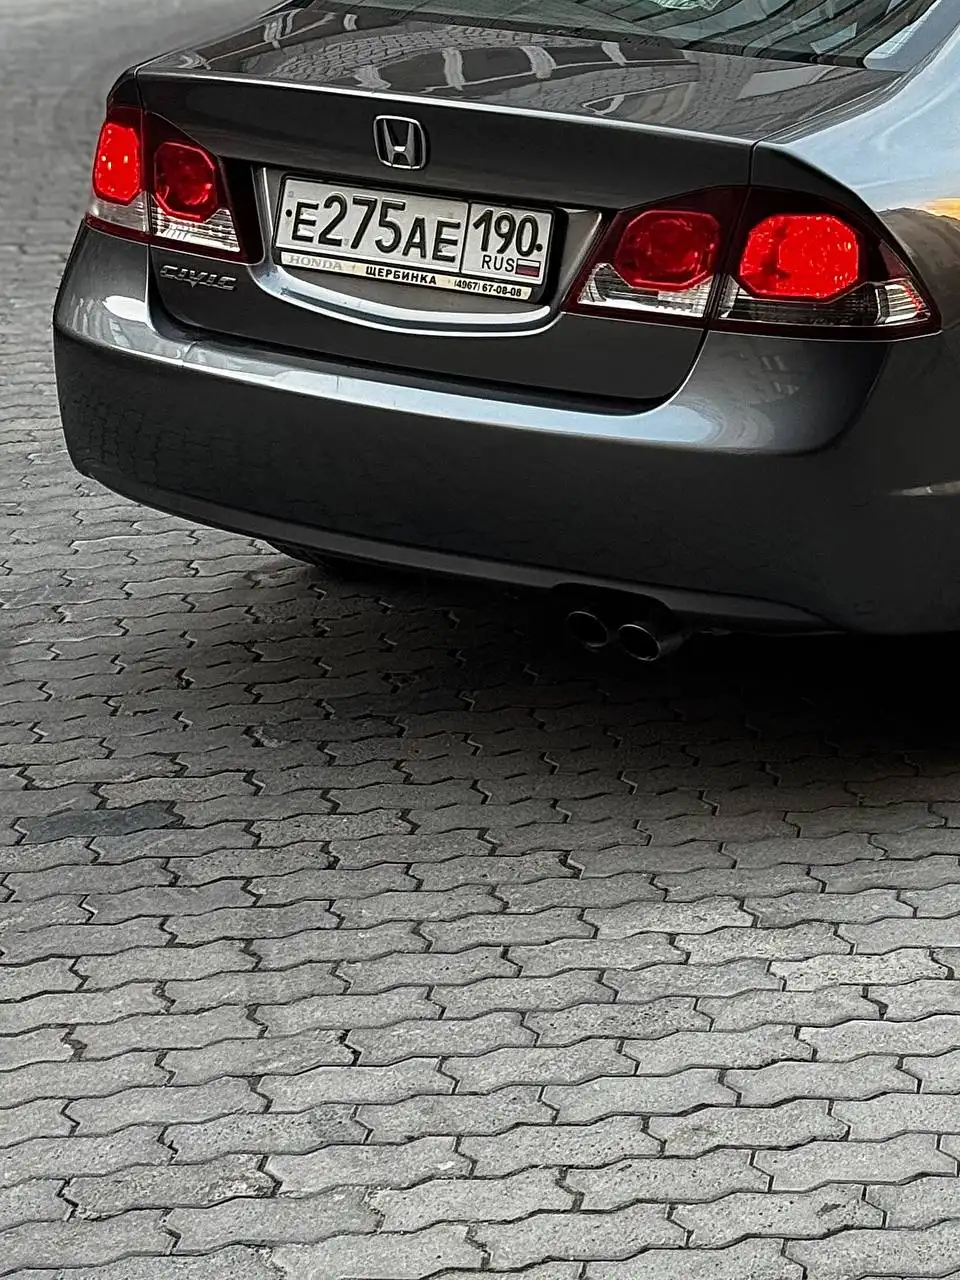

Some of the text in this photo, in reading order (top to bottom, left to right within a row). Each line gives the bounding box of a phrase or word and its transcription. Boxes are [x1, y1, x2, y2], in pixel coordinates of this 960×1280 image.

[472, 208, 539, 257] 190
[287, 254, 344, 271] HONDA
[482, 254, 515, 273] RUS
[365, 265, 437, 286] ЩЕРБИНКА
